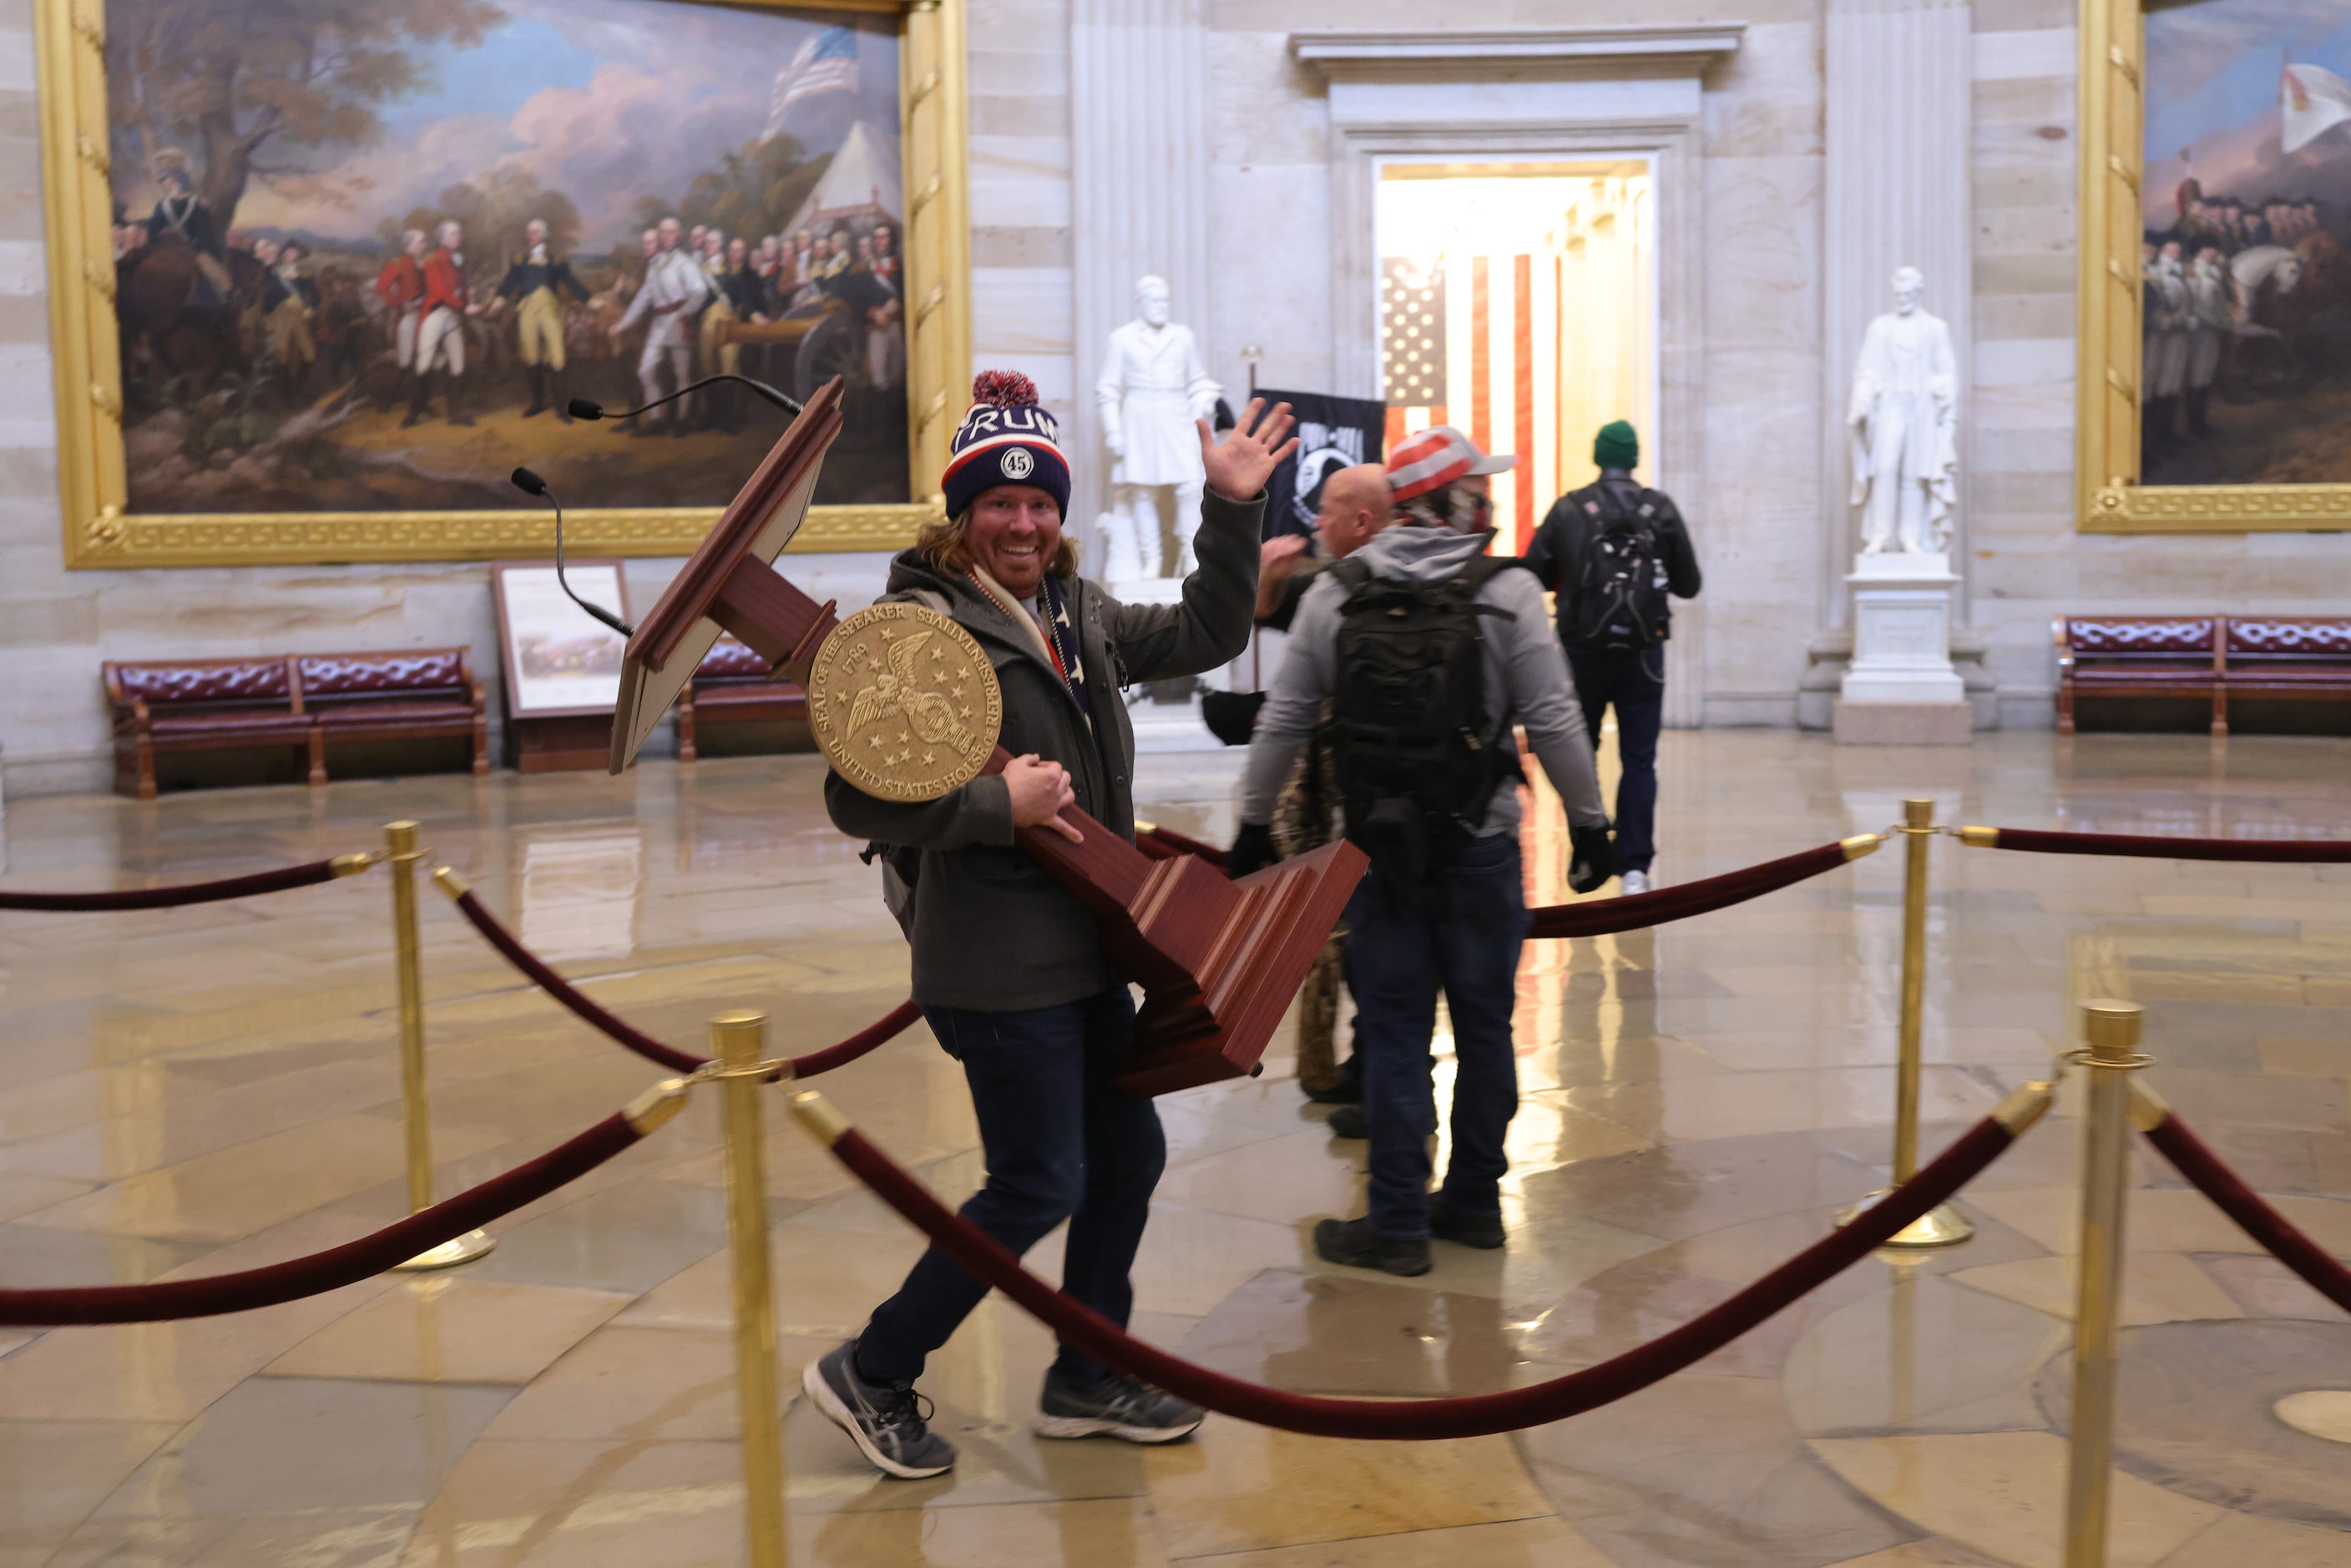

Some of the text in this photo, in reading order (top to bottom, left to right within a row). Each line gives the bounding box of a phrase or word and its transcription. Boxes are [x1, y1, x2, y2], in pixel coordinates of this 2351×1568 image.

[954, 407, 1059, 453] TRUM
[1008, 455, 1026, 471] 45
[812, 604, 906, 733] SEAL OF THE SPEAKER
[842, 642, 869, 675] 1789
[828, 606, 1000, 797] UNITED STATES HOUSE OF REPRESENTATIVES
